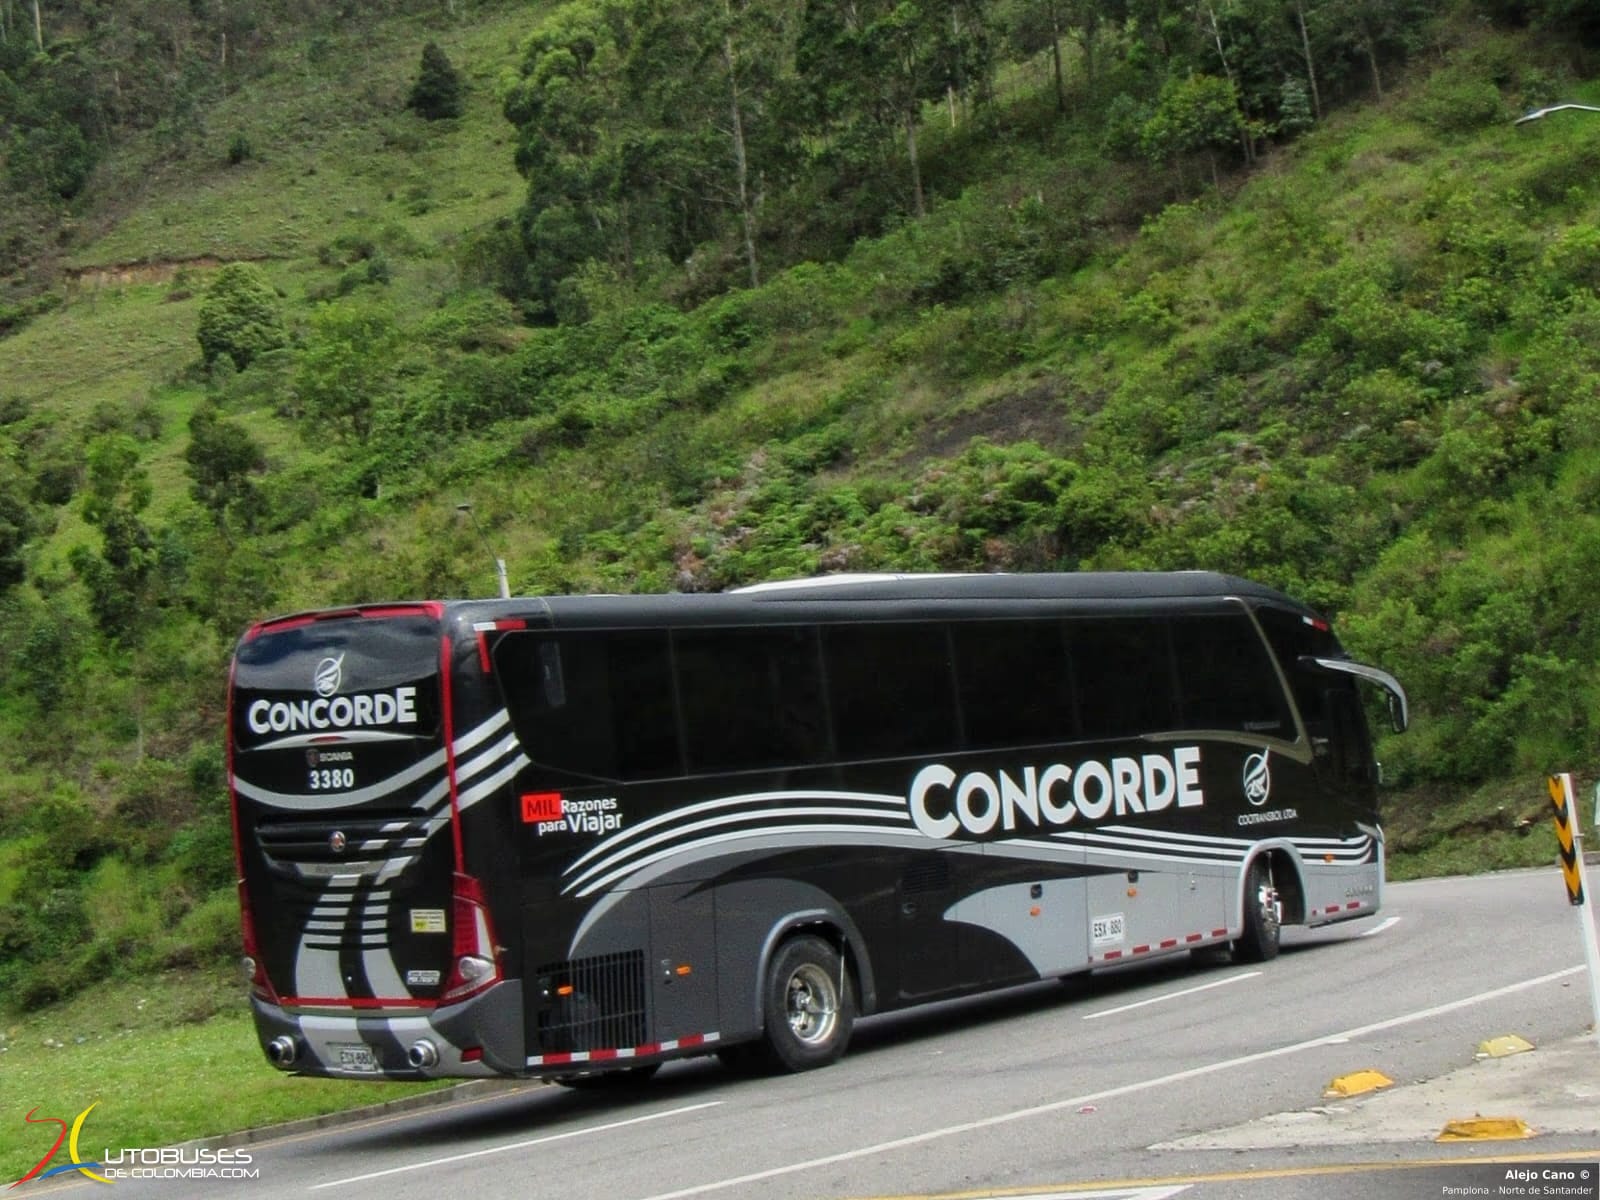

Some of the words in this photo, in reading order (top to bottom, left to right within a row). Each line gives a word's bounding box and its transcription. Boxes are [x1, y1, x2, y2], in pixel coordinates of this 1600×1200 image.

[249, 687, 417, 734] CONCORDE
[310, 768, 354, 790] 3380
[910, 746, 1204, 839] CONCORDE
[526, 800, 558, 817] MIL
[561, 798, 617, 814] Razones
[538, 819, 567, 836] para
[567, 810, 623, 836] Viajar
